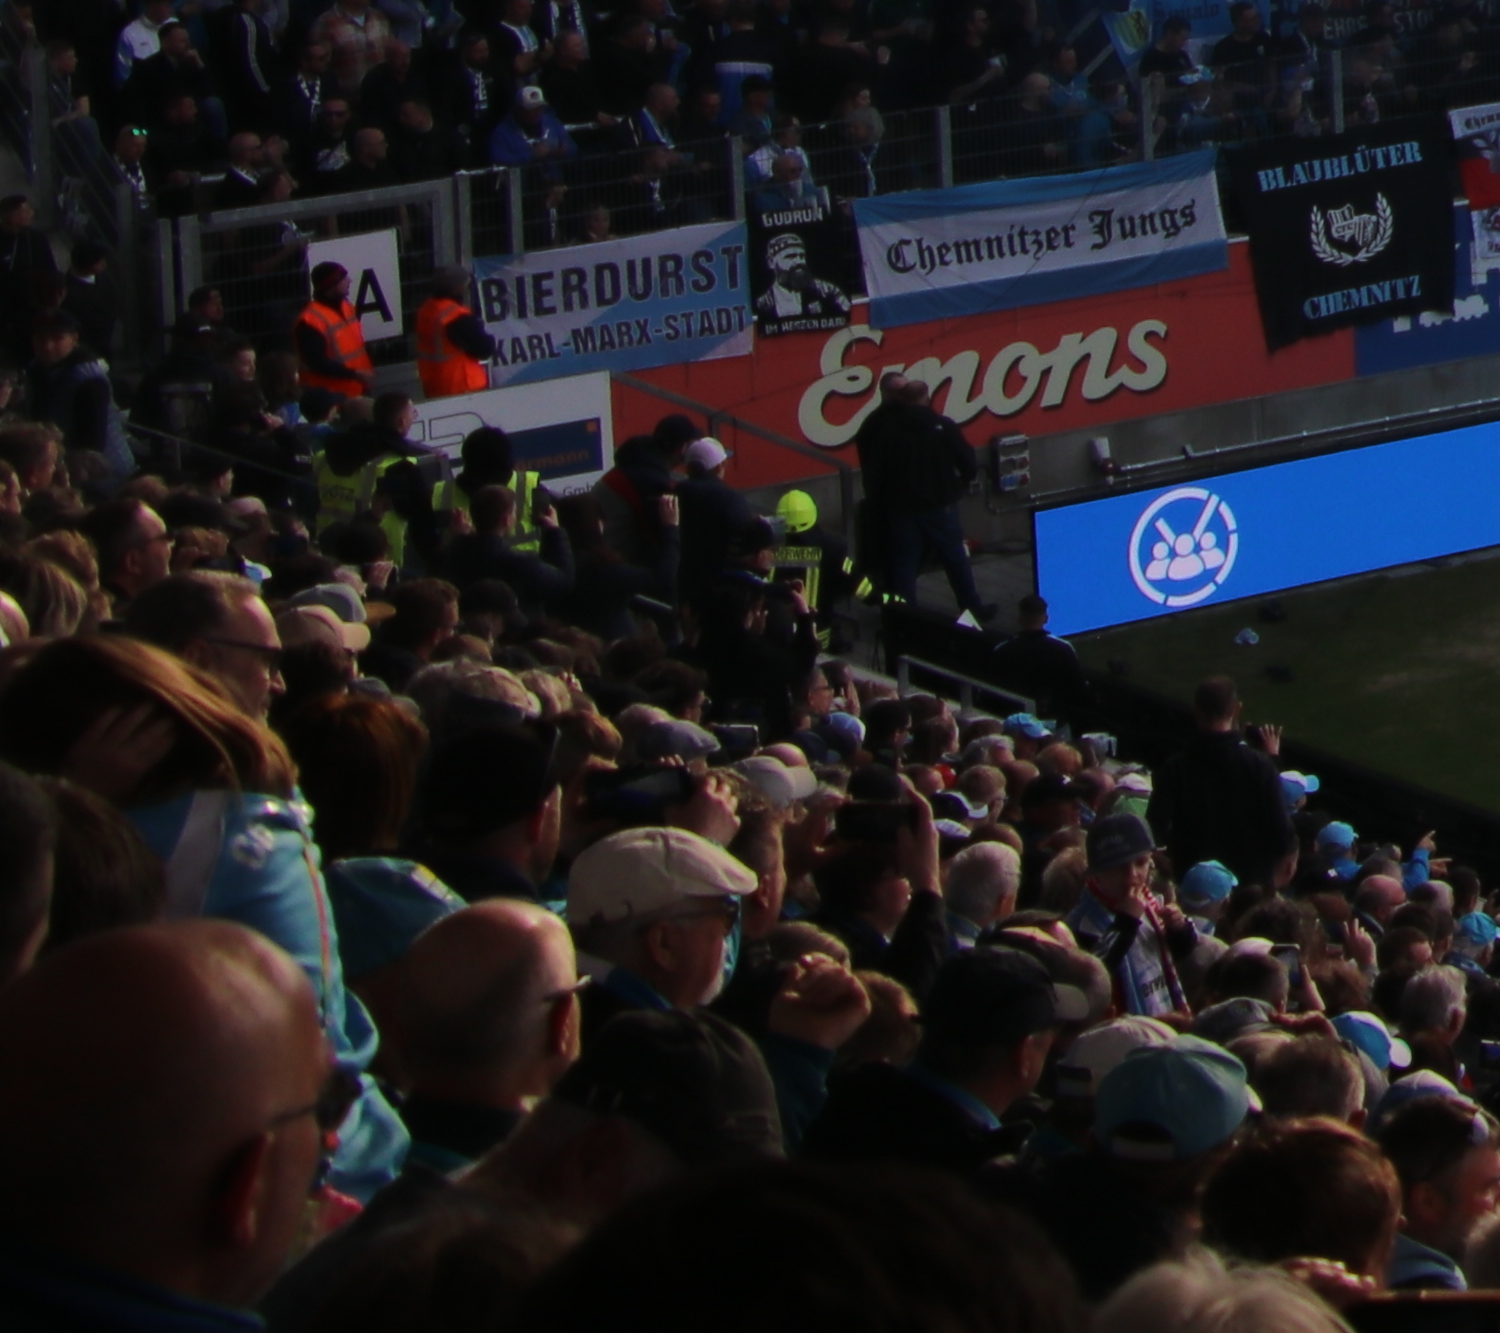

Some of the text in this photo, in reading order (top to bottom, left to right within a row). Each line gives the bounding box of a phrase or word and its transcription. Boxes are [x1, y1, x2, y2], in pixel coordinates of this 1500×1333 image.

[1256, 141, 1423, 193] BLAUBLÜTER
[761, 206, 824, 228] GUDRUN
[886, 197, 1198, 275] Chemnitzer Jungs
[481, 244, 745, 323] BIERDURST
[1303, 274, 1422, 320] CHEMNITZ
[492, 304, 748, 368] KARL-MARX-STADT
[797, 318, 1169, 447] Emons
